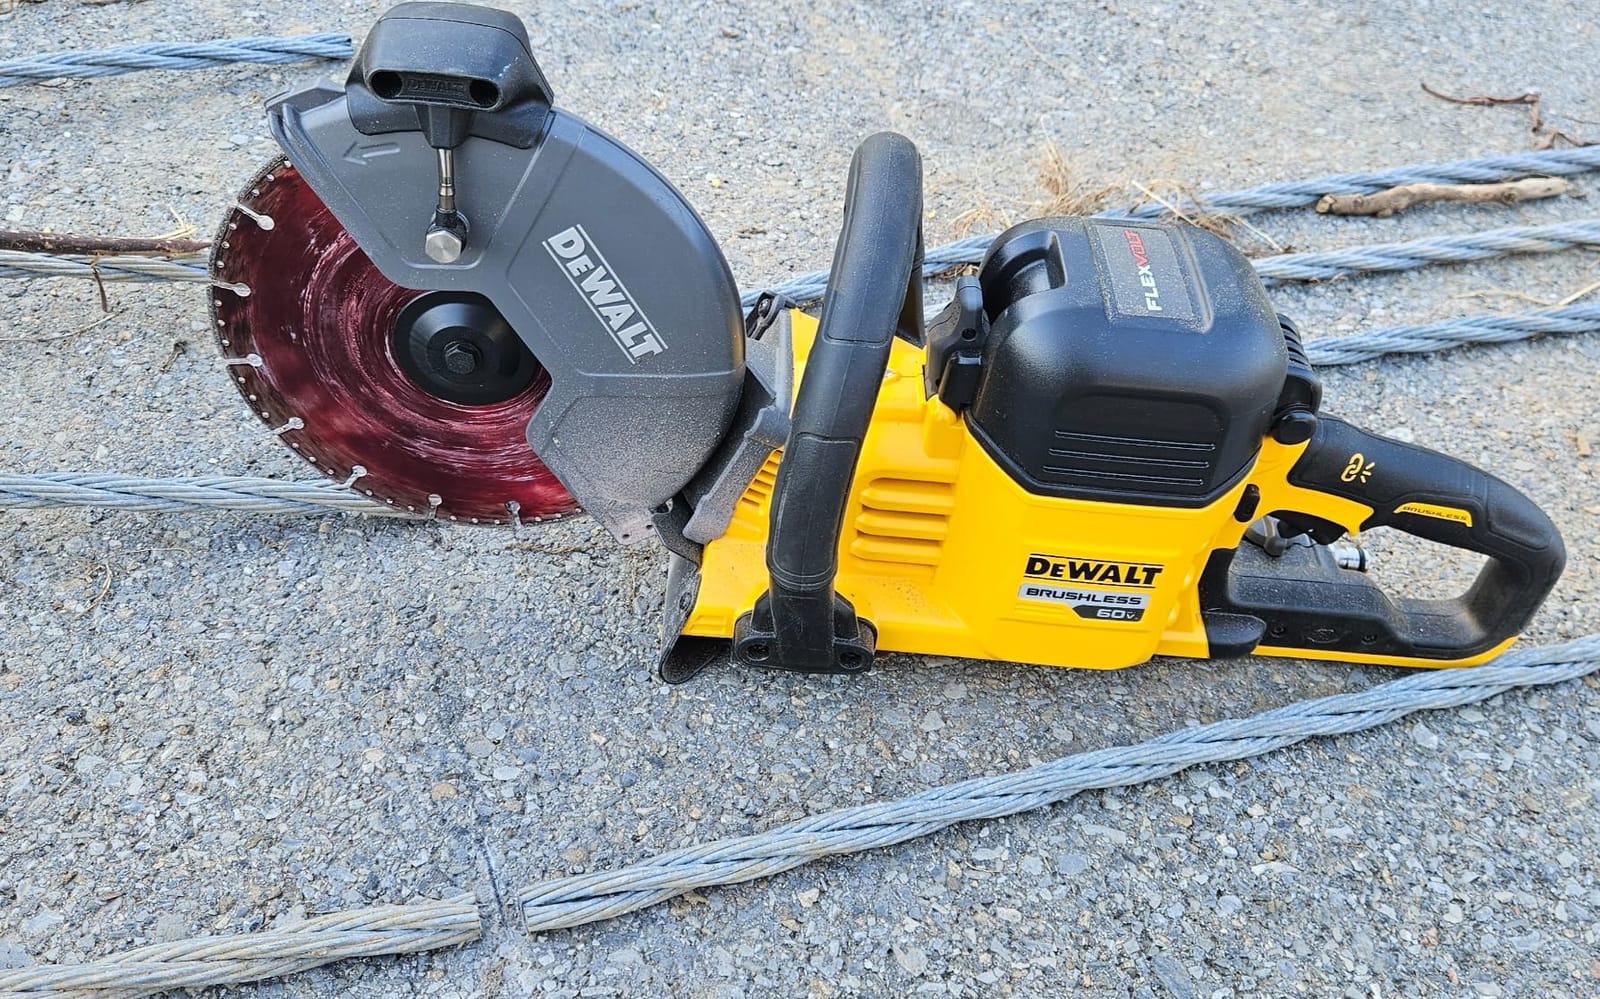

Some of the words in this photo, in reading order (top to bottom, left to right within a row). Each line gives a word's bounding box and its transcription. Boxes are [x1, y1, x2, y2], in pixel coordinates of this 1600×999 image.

[1123, 229, 1163, 311] FLEXVOLT
[547, 226, 664, 359] DEWALT
[1402, 506, 1467, 521] BRUSHLESS
[1024, 556, 1163, 585] DEWALT
[1026, 587, 1142, 605] BRUSHLESS
